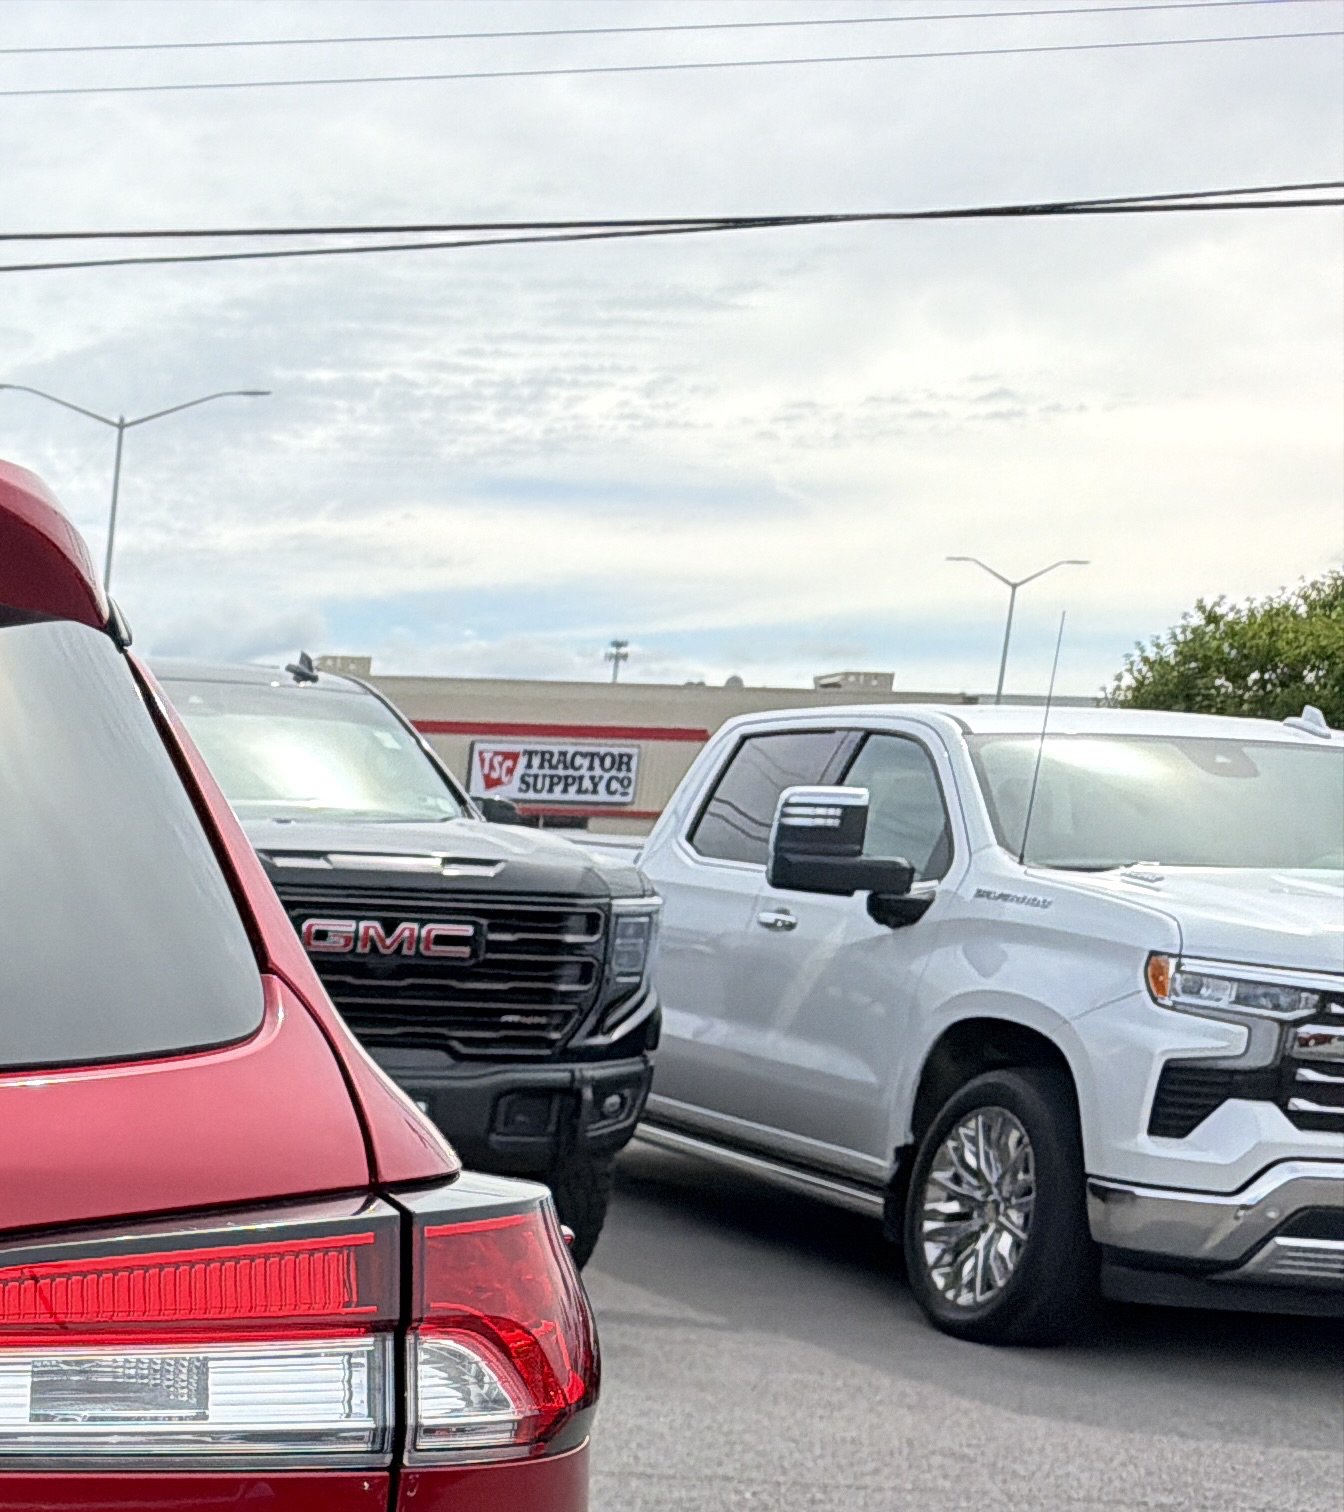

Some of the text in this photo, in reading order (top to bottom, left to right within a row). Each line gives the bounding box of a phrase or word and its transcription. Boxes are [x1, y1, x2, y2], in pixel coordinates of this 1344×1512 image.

[482, 751, 514, 785] TSC
[521, 749, 633, 773] TRACTOR
[518, 773, 603, 796] SUPPLY
[302, 918, 474, 958] GMC
